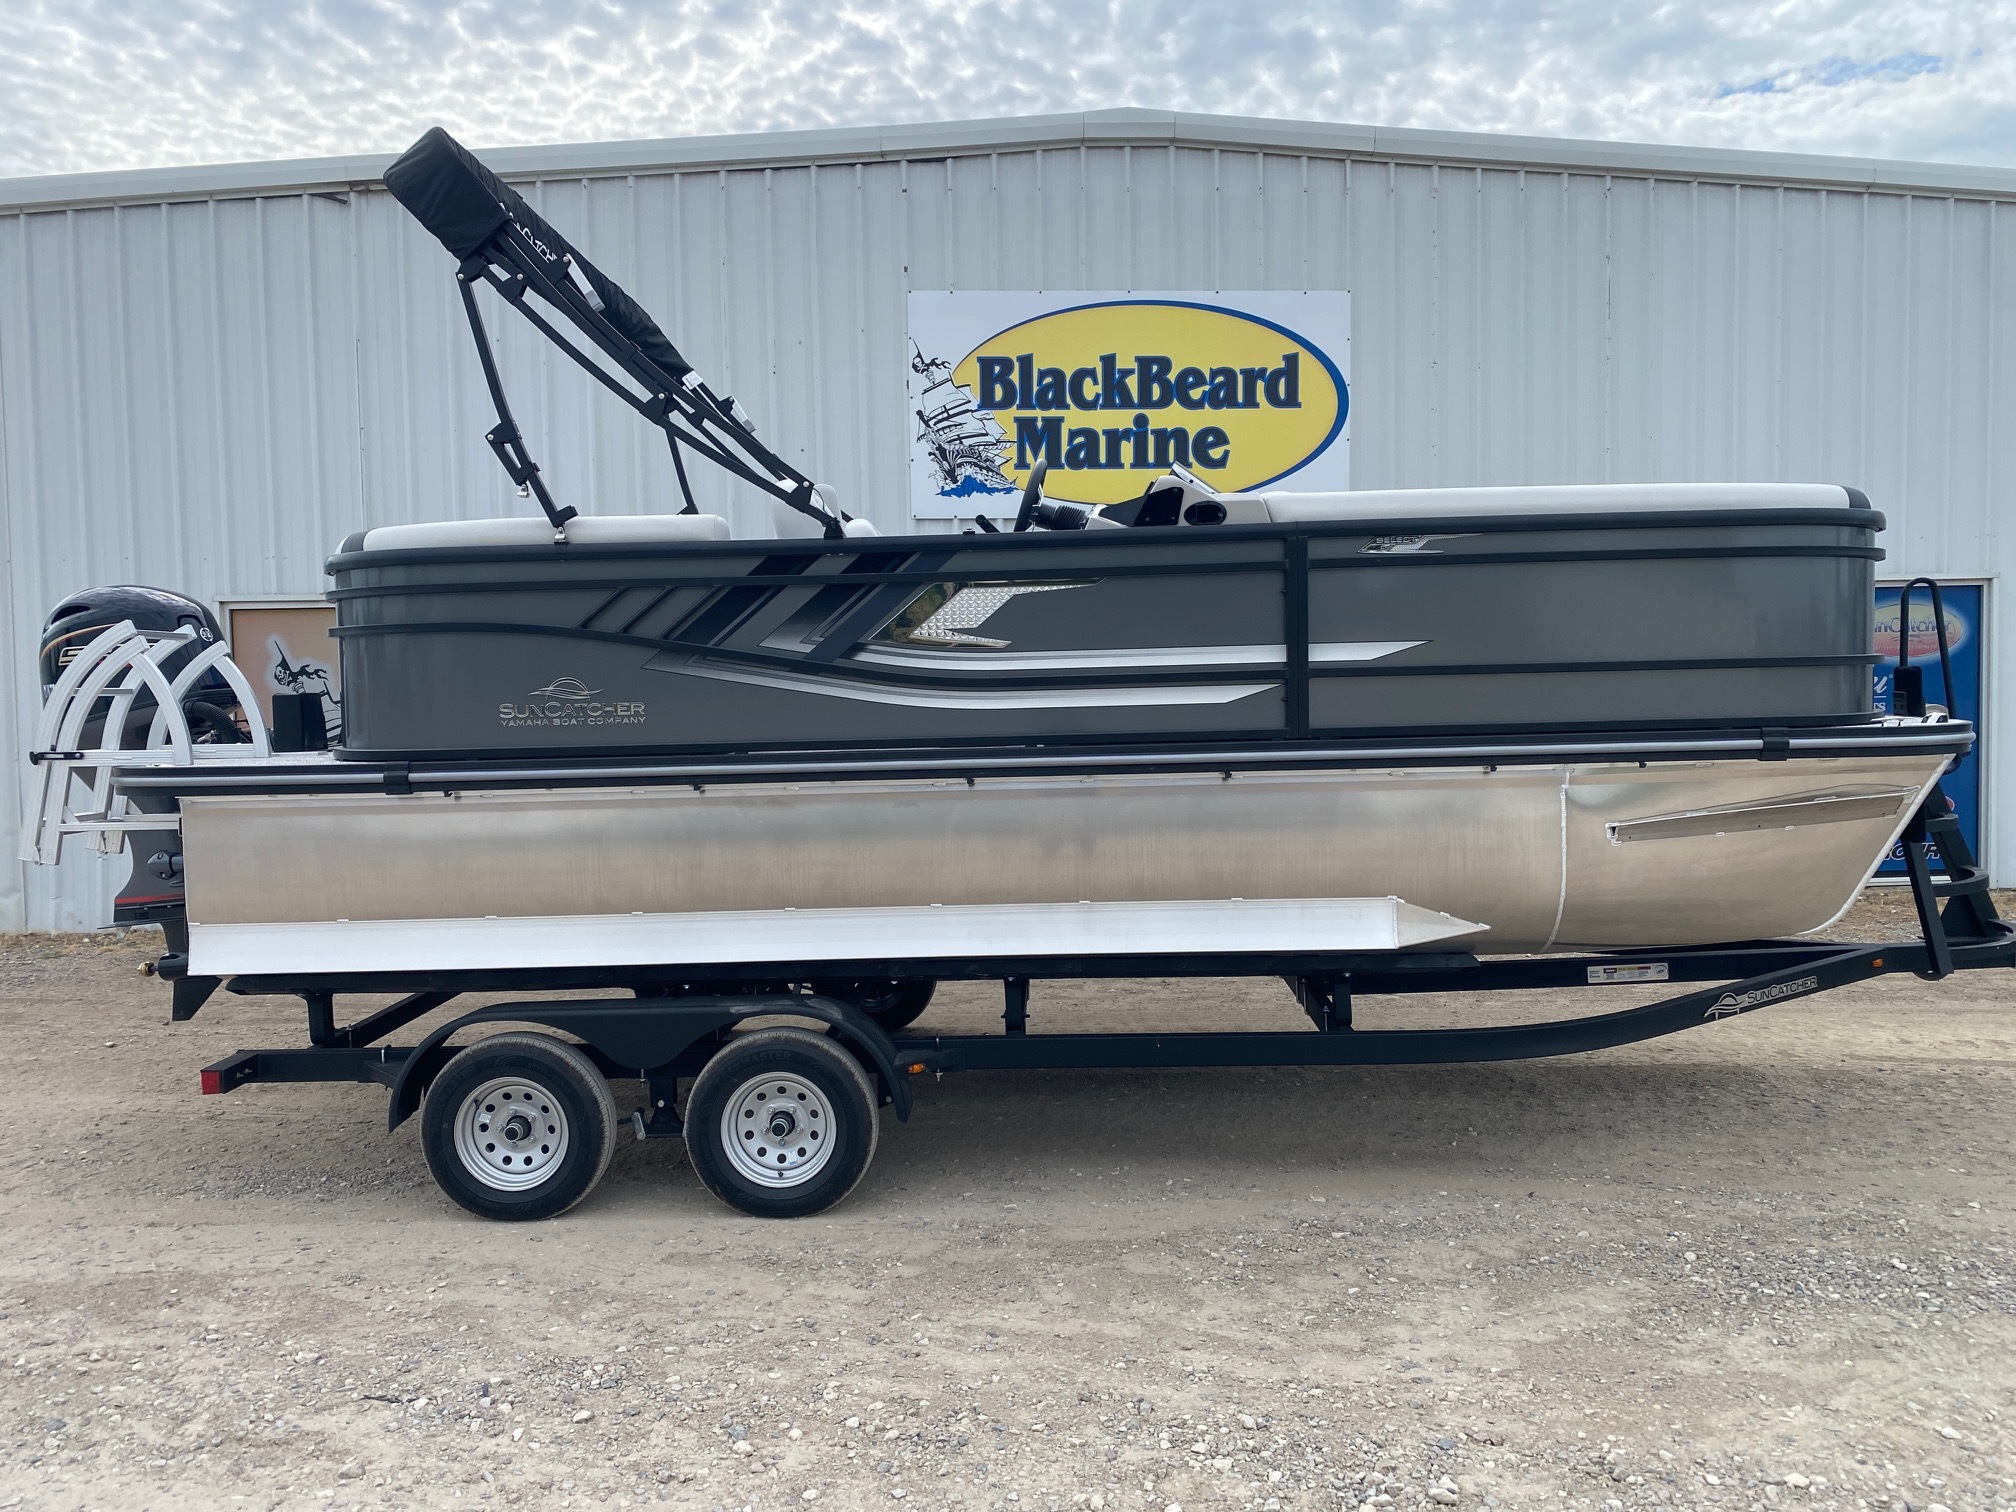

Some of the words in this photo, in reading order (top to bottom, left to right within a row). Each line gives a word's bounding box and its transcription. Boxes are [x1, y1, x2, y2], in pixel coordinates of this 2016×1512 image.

[976, 352, 1302, 411] BlackBeard
[1013, 413, 1231, 470] Marine
[1376, 536, 1418, 544] SELECT
[500, 718, 550, 727] YAMAHA
[553, 718, 585, 726] BOAT
[587, 716, 646, 726] COMPANY
